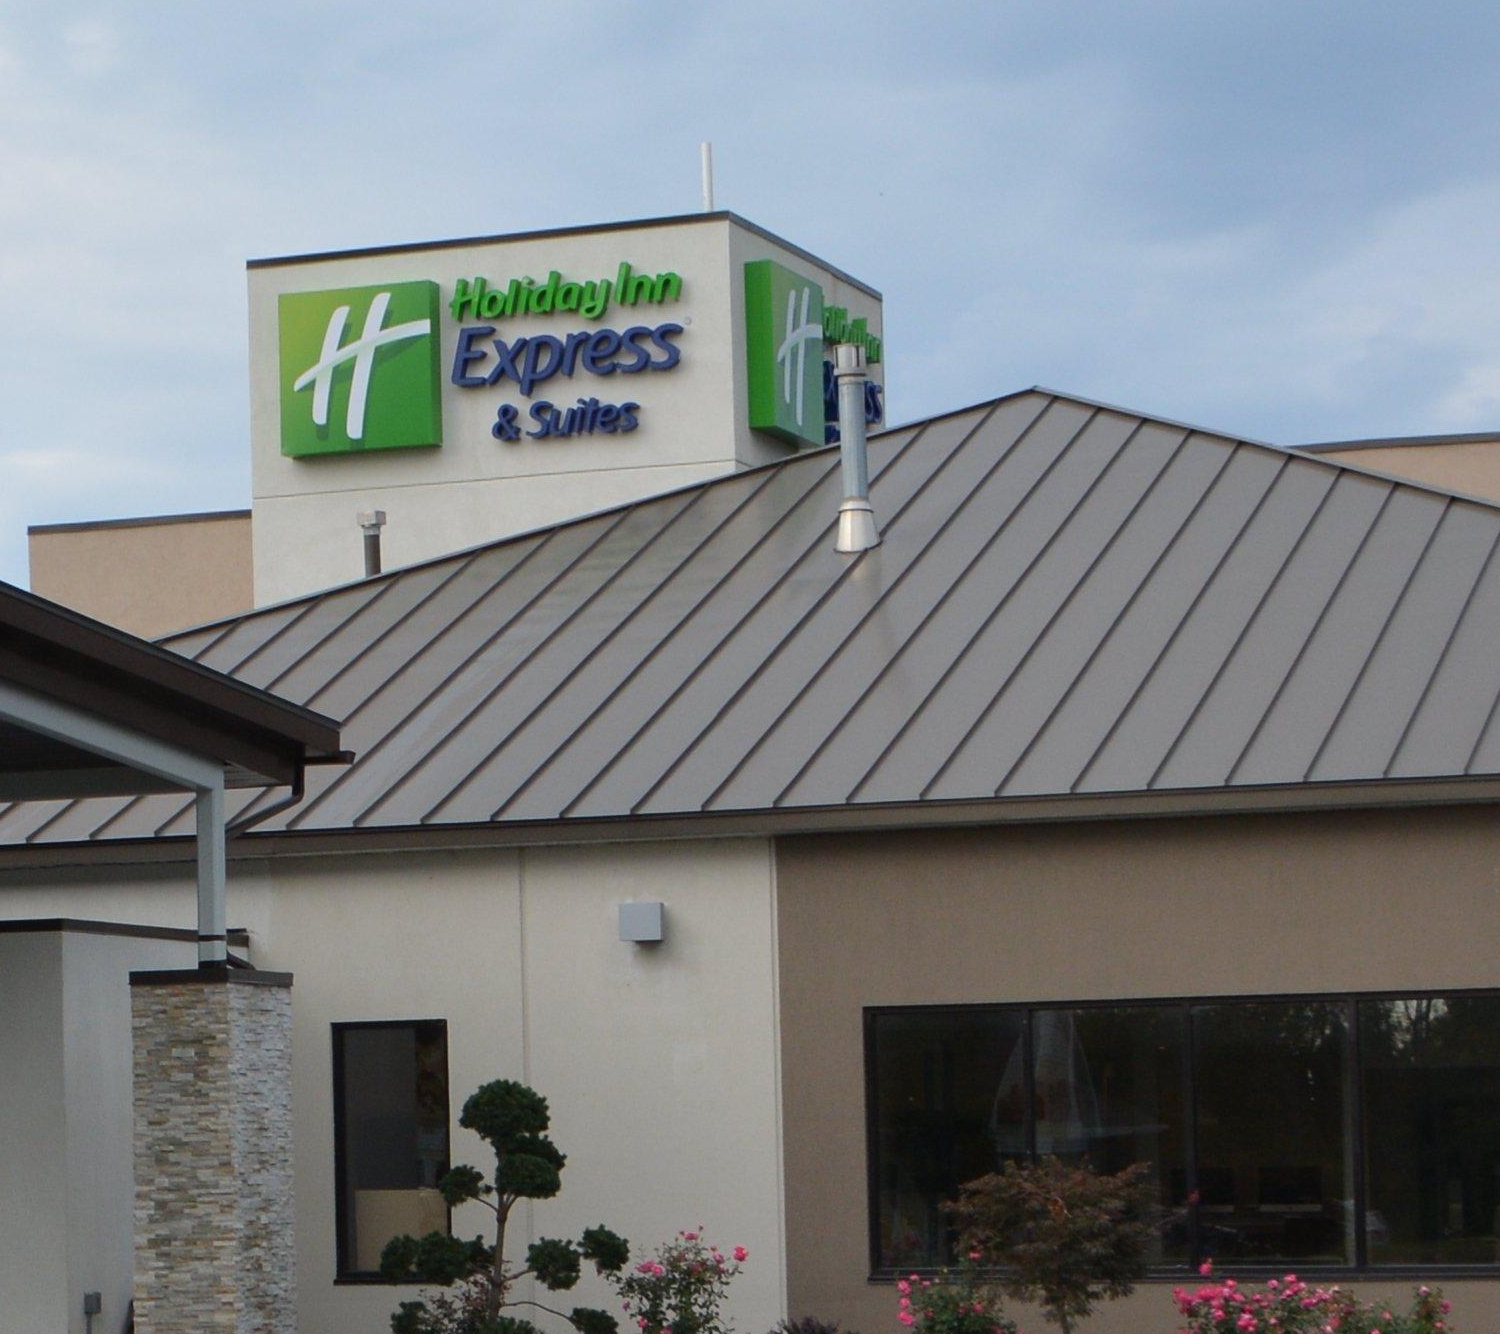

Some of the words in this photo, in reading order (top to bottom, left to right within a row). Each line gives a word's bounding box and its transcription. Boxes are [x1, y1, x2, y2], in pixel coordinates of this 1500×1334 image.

[449, 270, 613, 323] Holiday
[614, 261, 683, 306] Inn
[451, 323, 685, 398] Express
[491, 403, 522, 442] &
[525, 397, 641, 440] Suites
